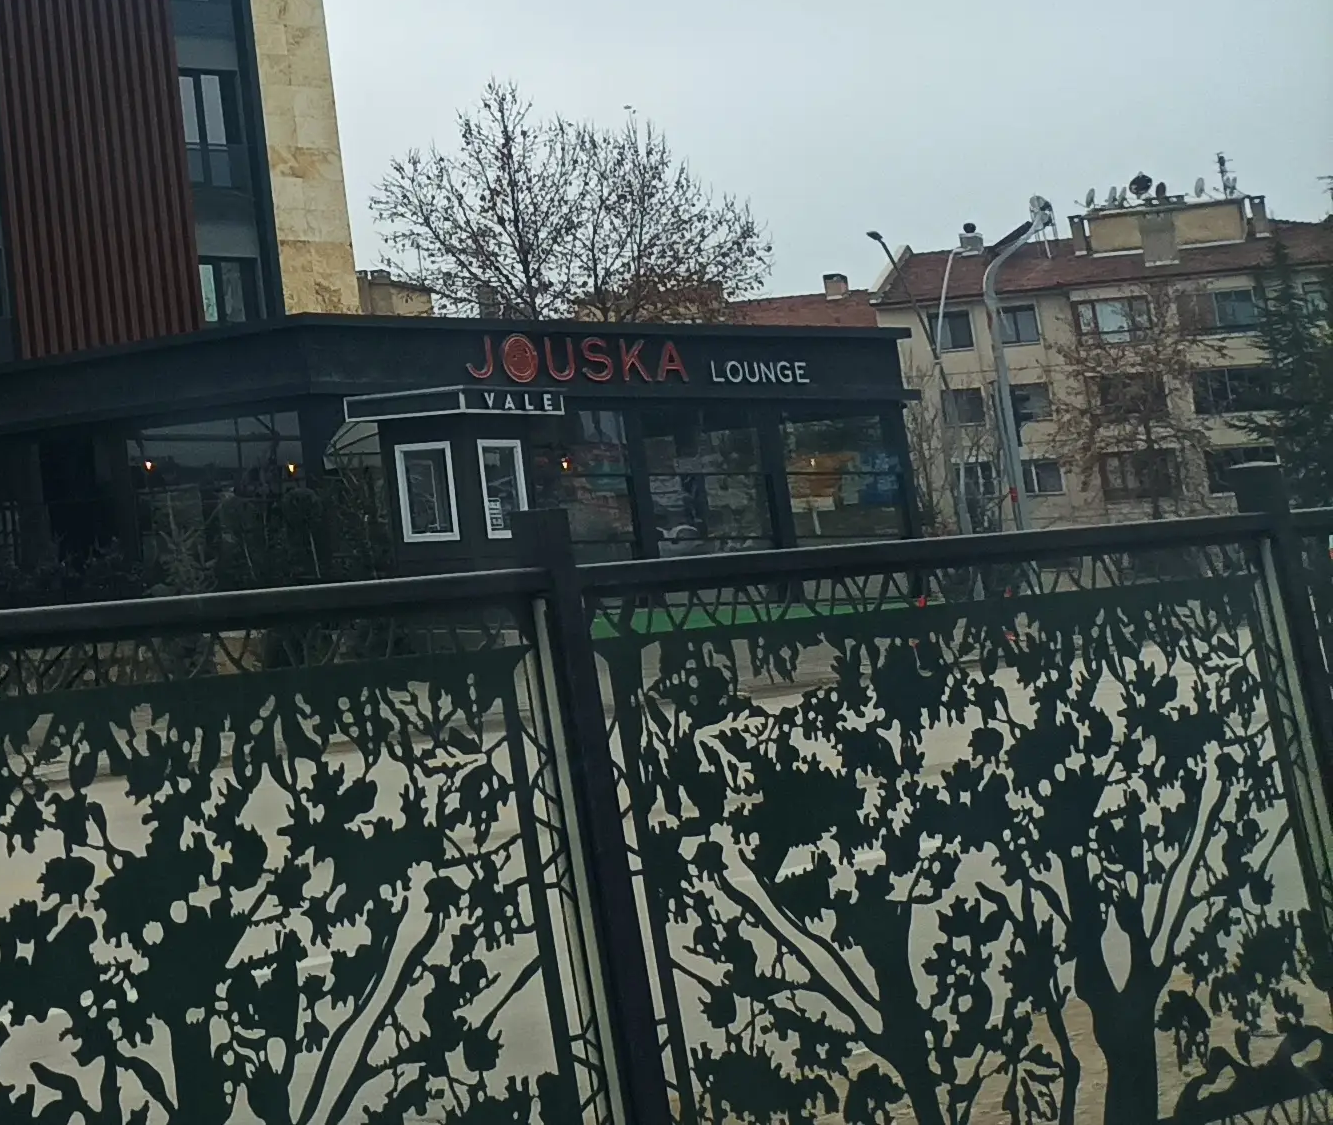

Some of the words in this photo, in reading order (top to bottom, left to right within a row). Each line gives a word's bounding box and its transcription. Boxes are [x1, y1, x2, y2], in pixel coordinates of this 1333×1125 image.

[466, 333, 689, 382] JOUSKA
[710, 360, 810, 383] LOUNGE
[484, 392, 553, 411] VALE
